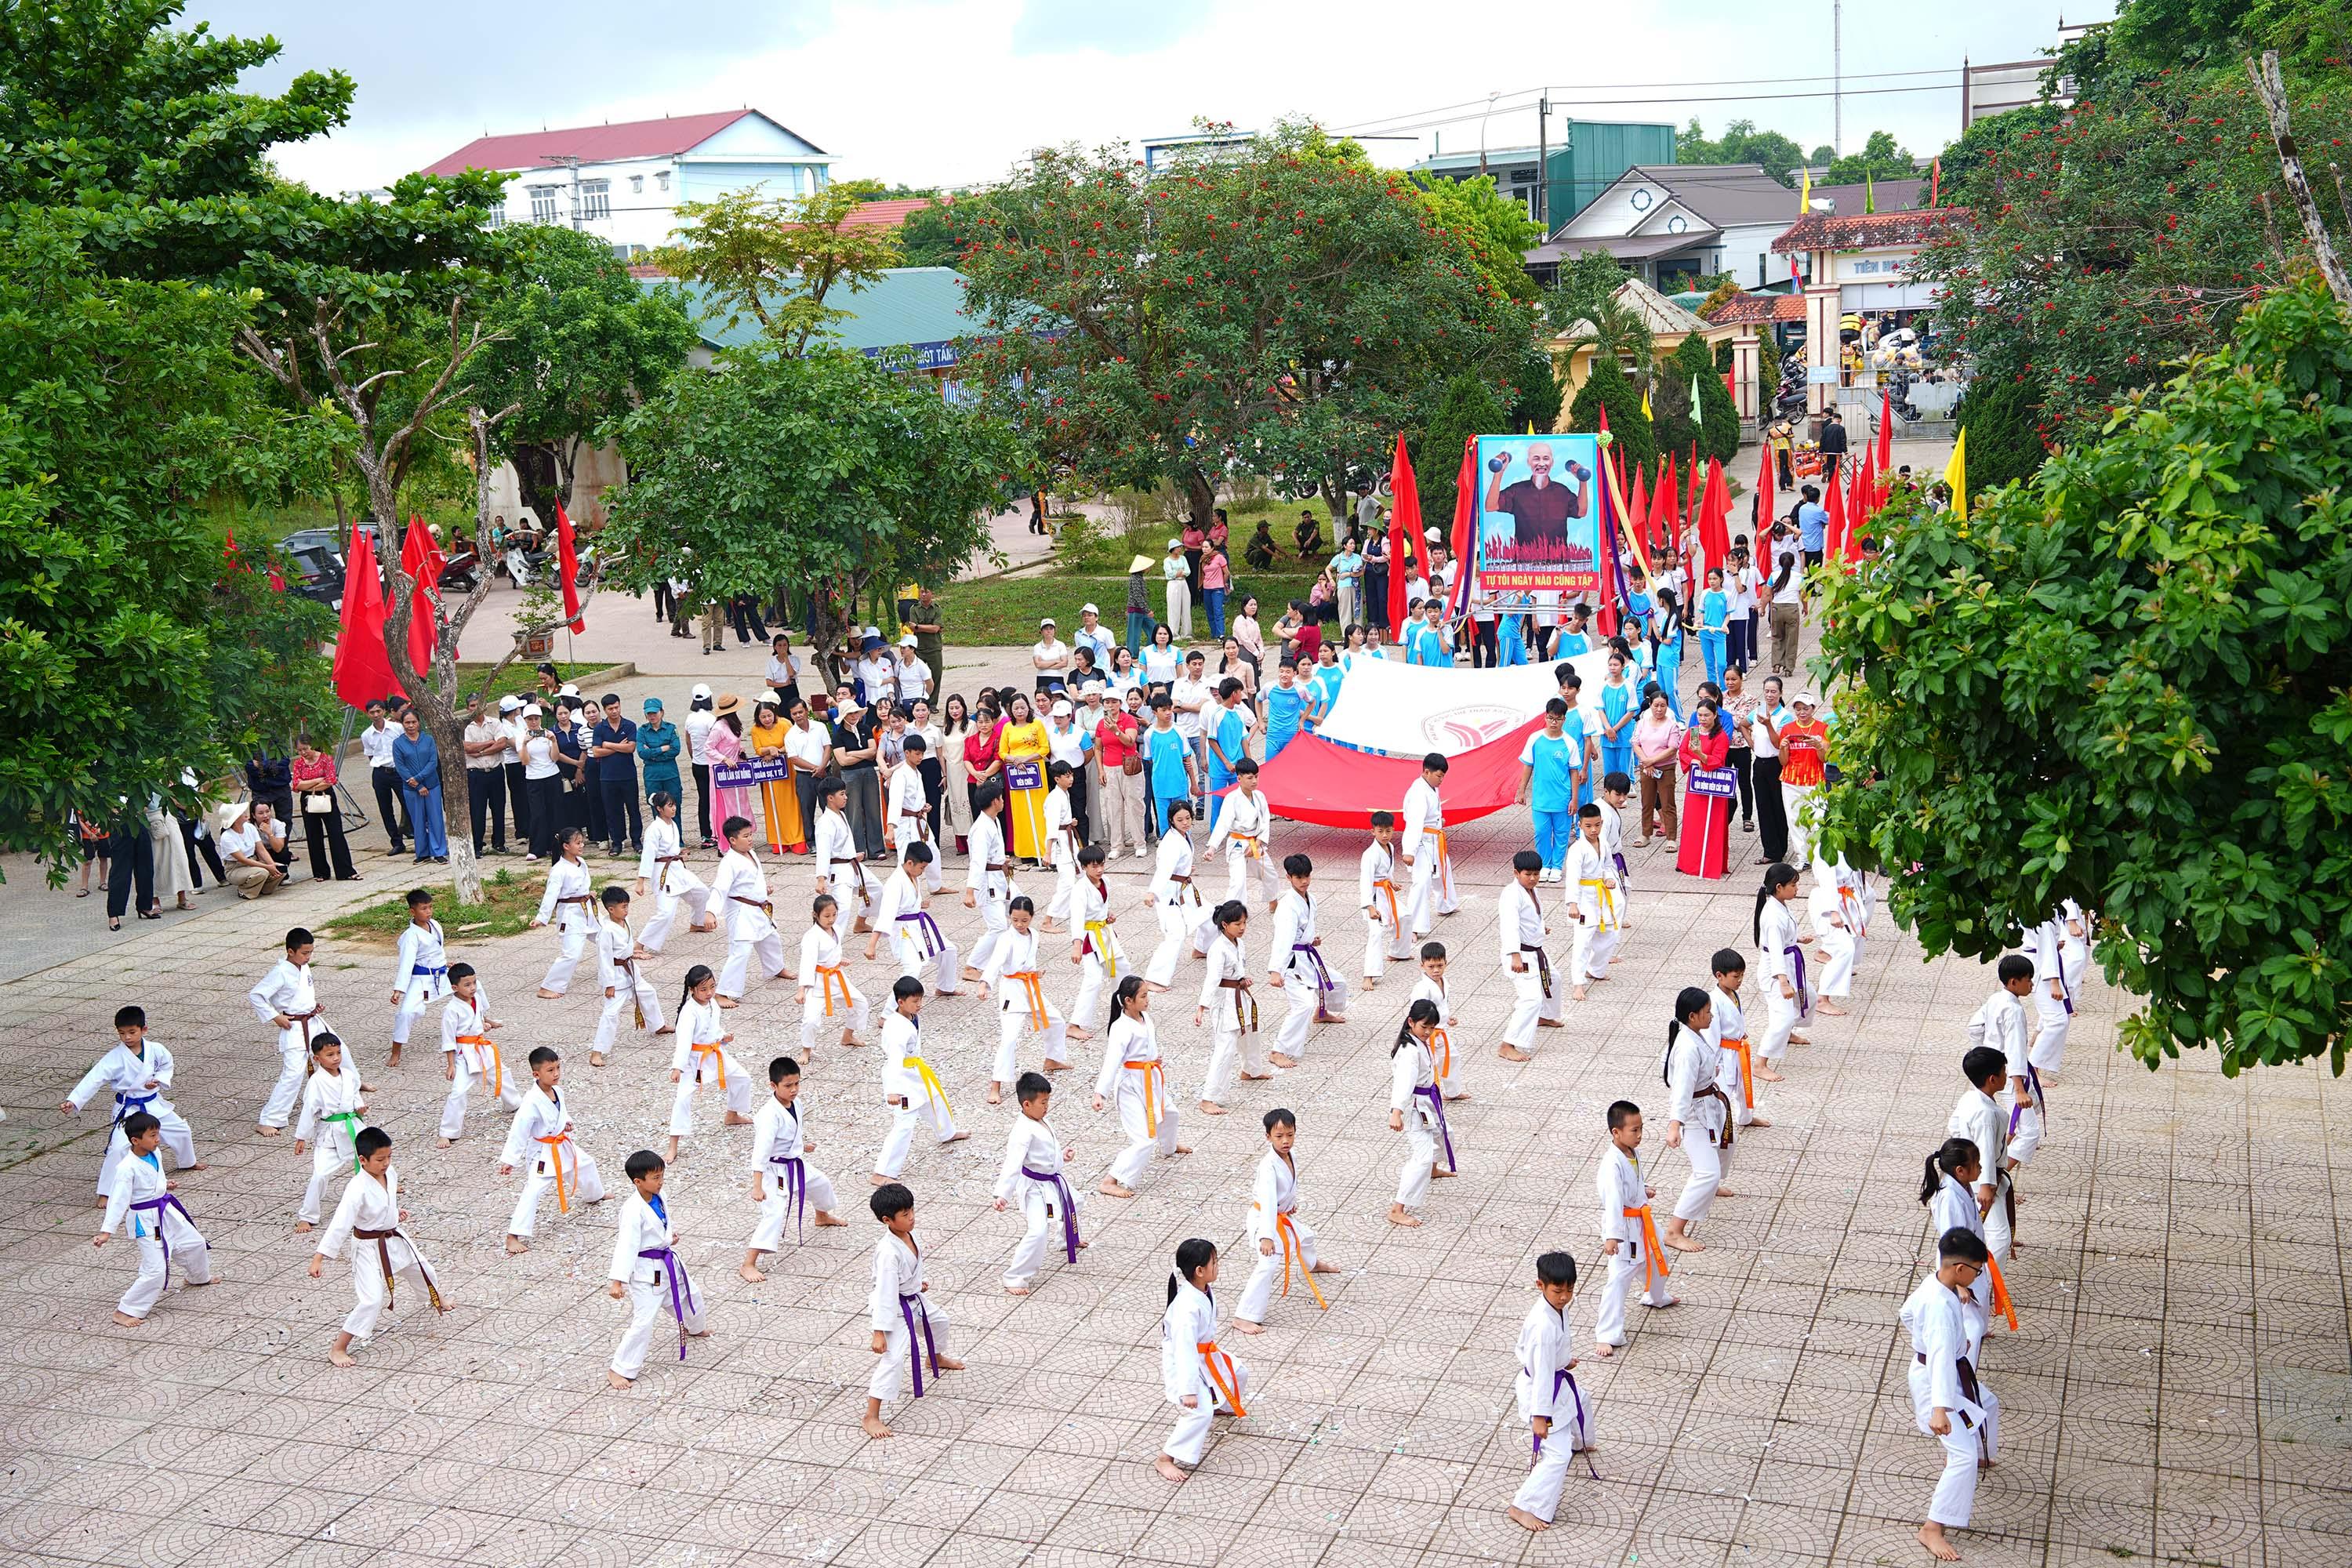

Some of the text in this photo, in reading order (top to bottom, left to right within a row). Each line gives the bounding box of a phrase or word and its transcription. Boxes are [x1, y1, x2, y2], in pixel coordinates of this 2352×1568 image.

[1854, 260, 1878, 274] TIÊN
[1486, 573, 1593, 588] TỰ TÔI NGÀY NÀO CŨNG TẬP
[717, 769, 727, 781] KHỐI
